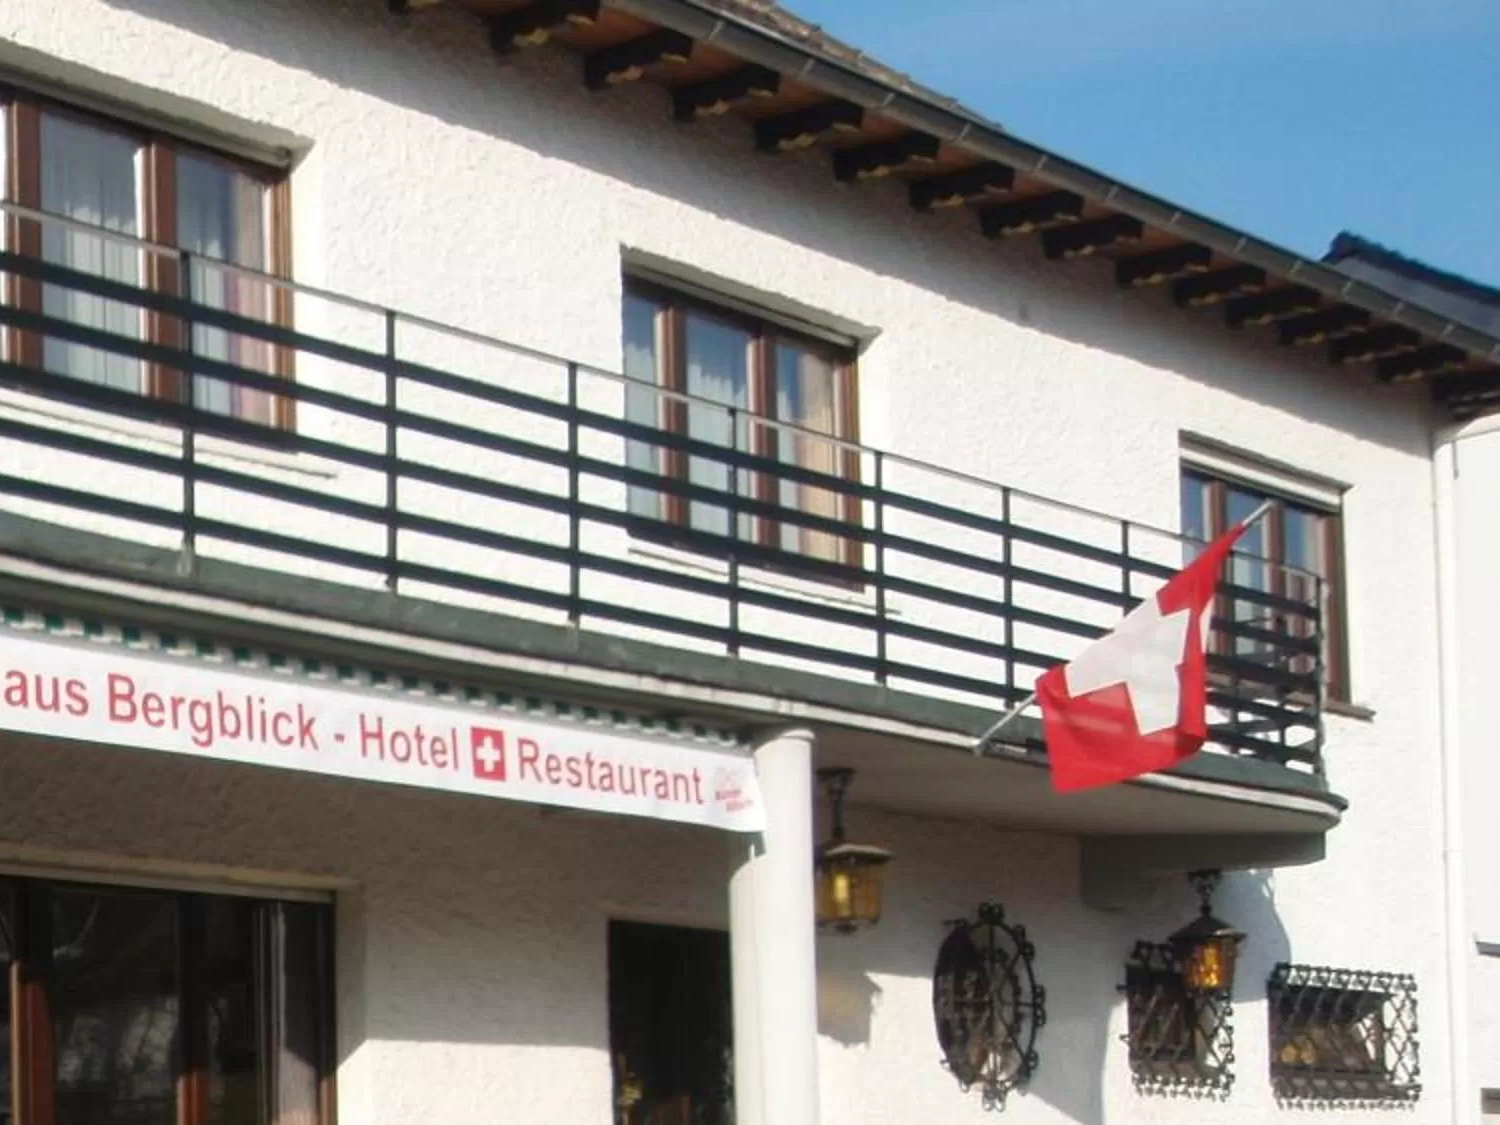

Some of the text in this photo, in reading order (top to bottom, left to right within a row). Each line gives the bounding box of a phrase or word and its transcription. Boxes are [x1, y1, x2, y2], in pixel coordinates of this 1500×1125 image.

[106, 672, 320, 751] Bergblick
[359, 712, 460, 771] Hotel
[516, 738, 704, 805] Restaurant
